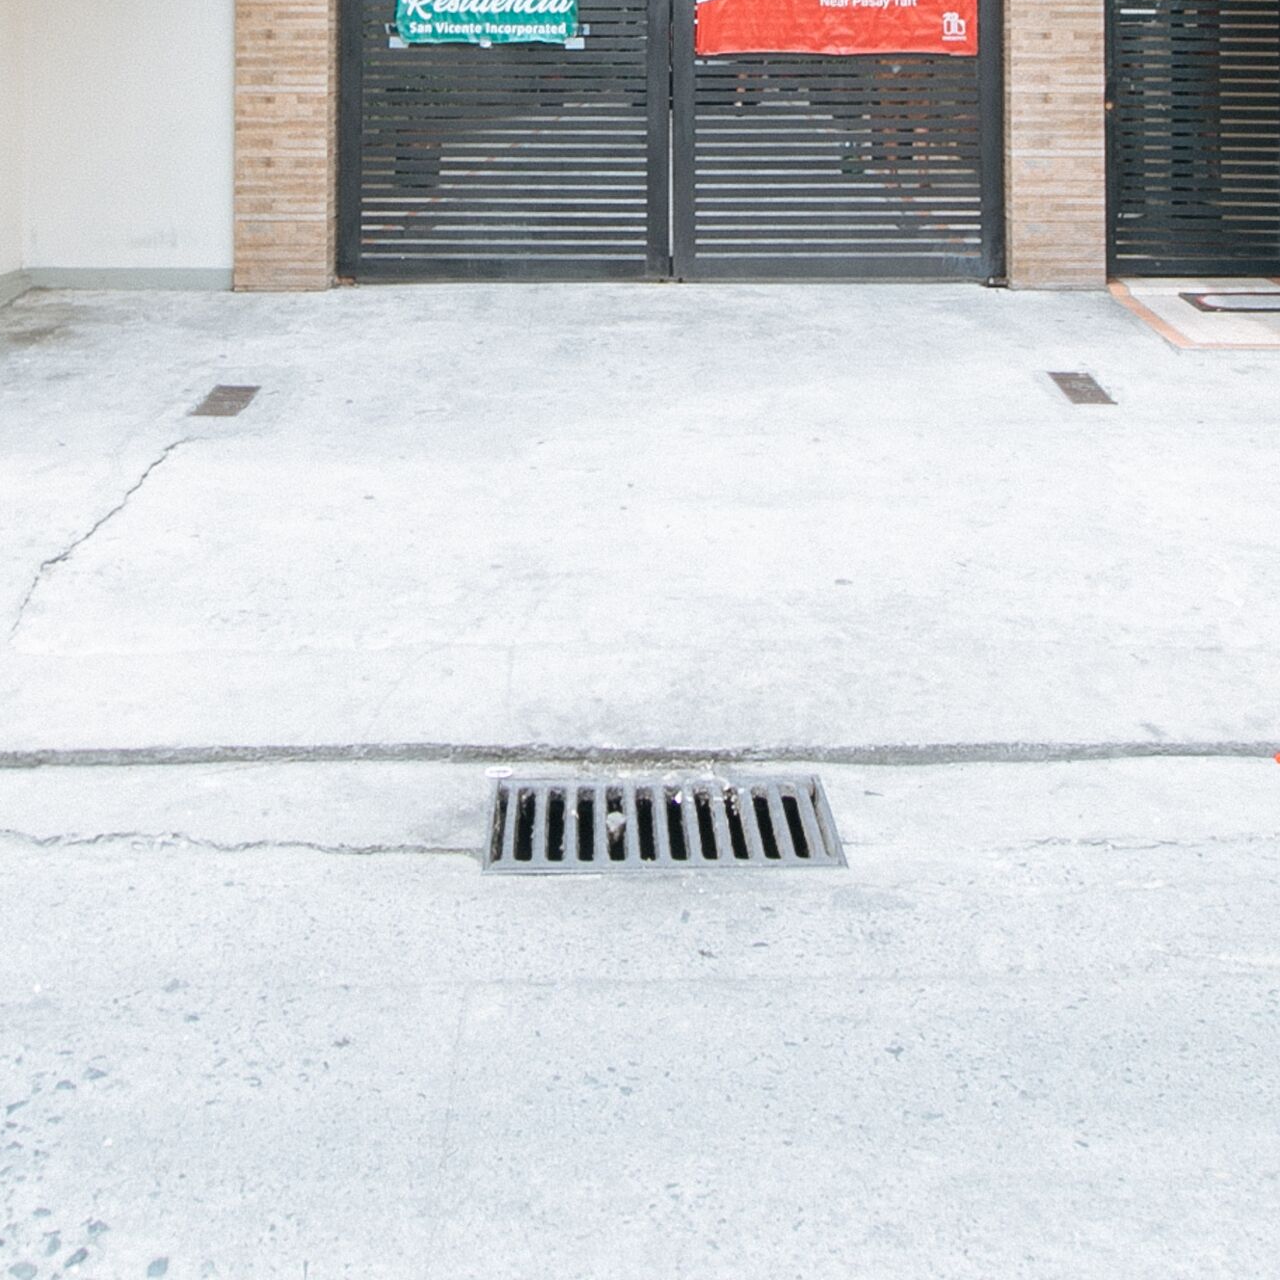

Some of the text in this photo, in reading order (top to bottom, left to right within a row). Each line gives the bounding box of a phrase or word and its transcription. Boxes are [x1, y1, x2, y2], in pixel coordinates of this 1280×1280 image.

[409, 22, 567, 36] San Vicente Incorporated
